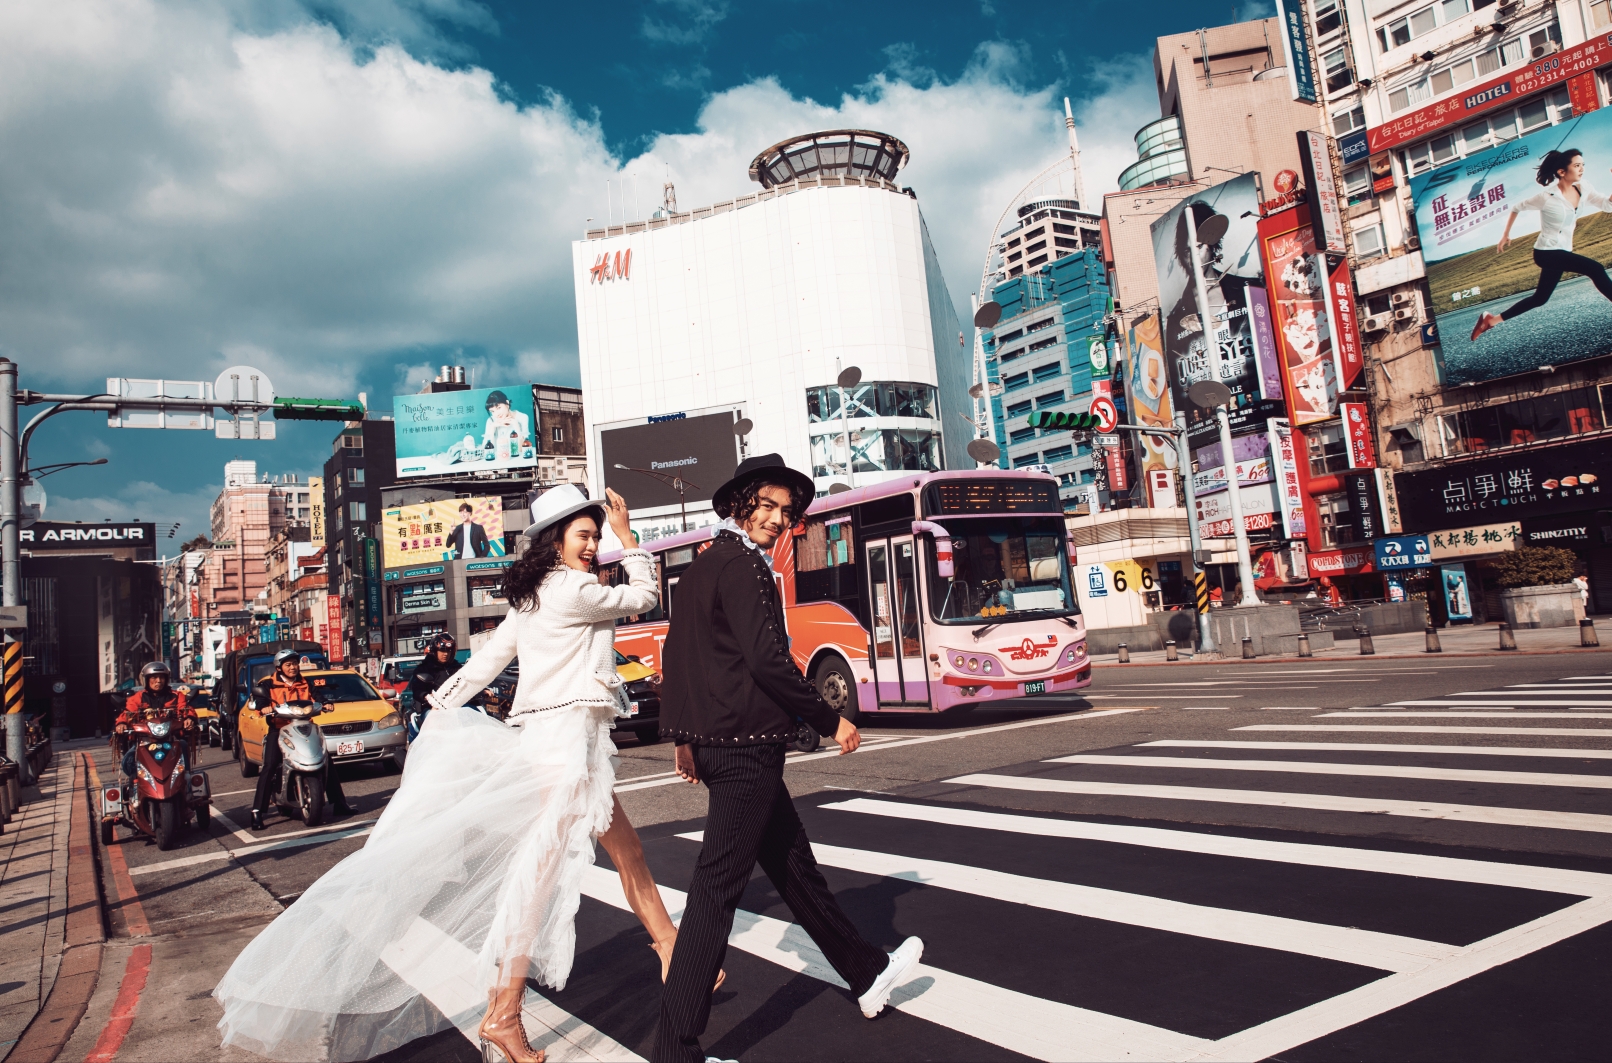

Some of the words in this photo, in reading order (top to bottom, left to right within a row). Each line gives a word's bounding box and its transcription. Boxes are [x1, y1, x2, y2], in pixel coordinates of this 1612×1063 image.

[1515, 55, 1600, 93] (02)2314-4003
[1466, 84, 1510, 108] HOTEL
[1398, 128, 1416, 139] Diary
[1425, 117, 1445, 129] Taipei
[1465, 145, 1529, 173] SKECHERS
[1466, 151, 1530, 176] PERFORMANCE
[1432, 193, 1450, 215] 征
[1434, 183, 1506, 231] 無法設限
[589, 248, 632, 284] H&M
[436, 405, 475, 417] 美生貝樂
[648, 412, 687, 424] Panasonic
[1279, 435, 1294, 462] 按摩
[651, 456, 698, 470] Panasonic
[1284, 471, 1299, 498] 護膚
[313, 505, 322, 535] HOTEL
[1204, 508, 1219, 518] RICH
[42, 528, 143, 541] ARMOUR
[398, 522, 443, 538] 有點厲害
[1433, 525, 1523, 549] 成都楊桃冰
[1310, 555, 1334, 570] COLD
[1333, 552, 1365, 566] STONE
[1113, 570, 1127, 592] 6
[1141, 567, 1154, 590] 6
[1025, 682, 1045, 693] 819-FT
